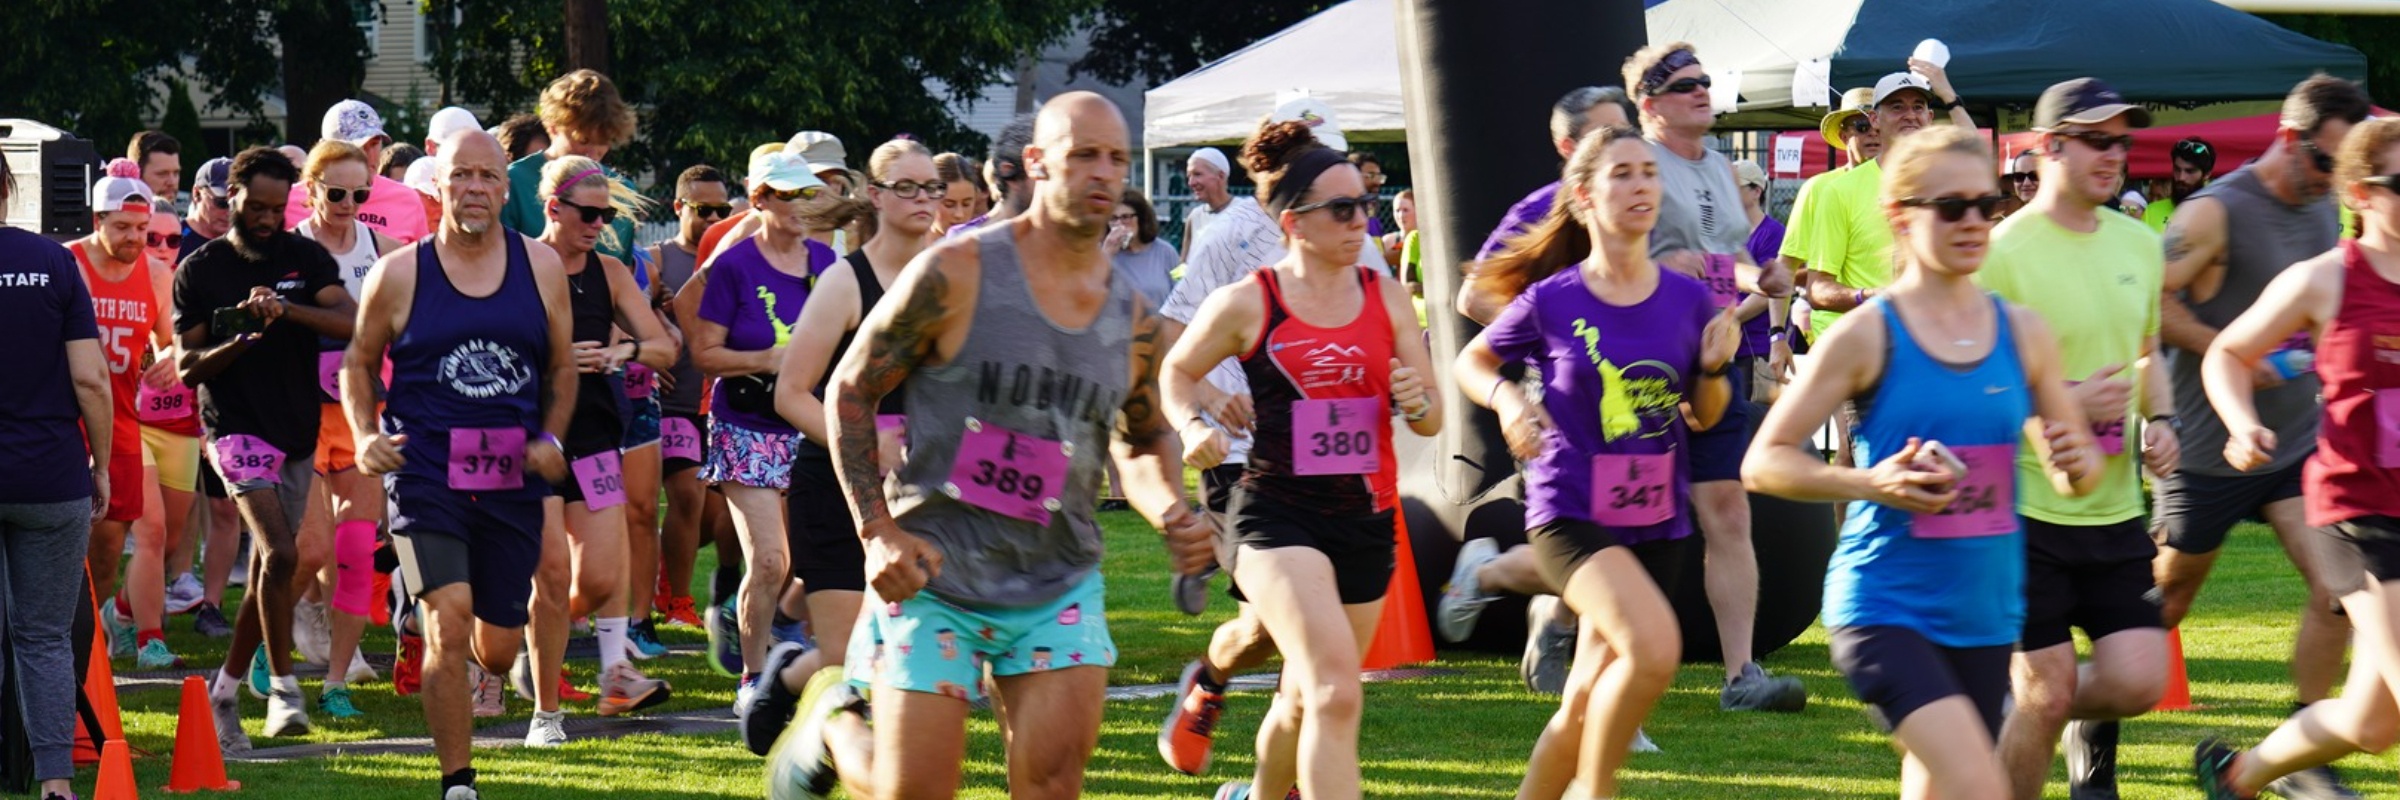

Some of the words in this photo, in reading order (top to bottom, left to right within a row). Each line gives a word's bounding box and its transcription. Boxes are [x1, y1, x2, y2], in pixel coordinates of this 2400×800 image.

[355, 213, 388, 227] OBA
[0, 272, 50, 287] TAFF
[91, 297, 116, 319] RTH
[118, 299, 148, 323] POLE
[624, 372, 646, 389] 54
[150, 394, 184, 411] 398
[663, 434, 694, 449] 327
[1311, 431, 1371, 457] 380
[231, 454, 276, 469] 382
[463, 454, 513, 475] 379
[971, 459, 1044, 501] 389
[1609, 484, 1667, 510] 347
